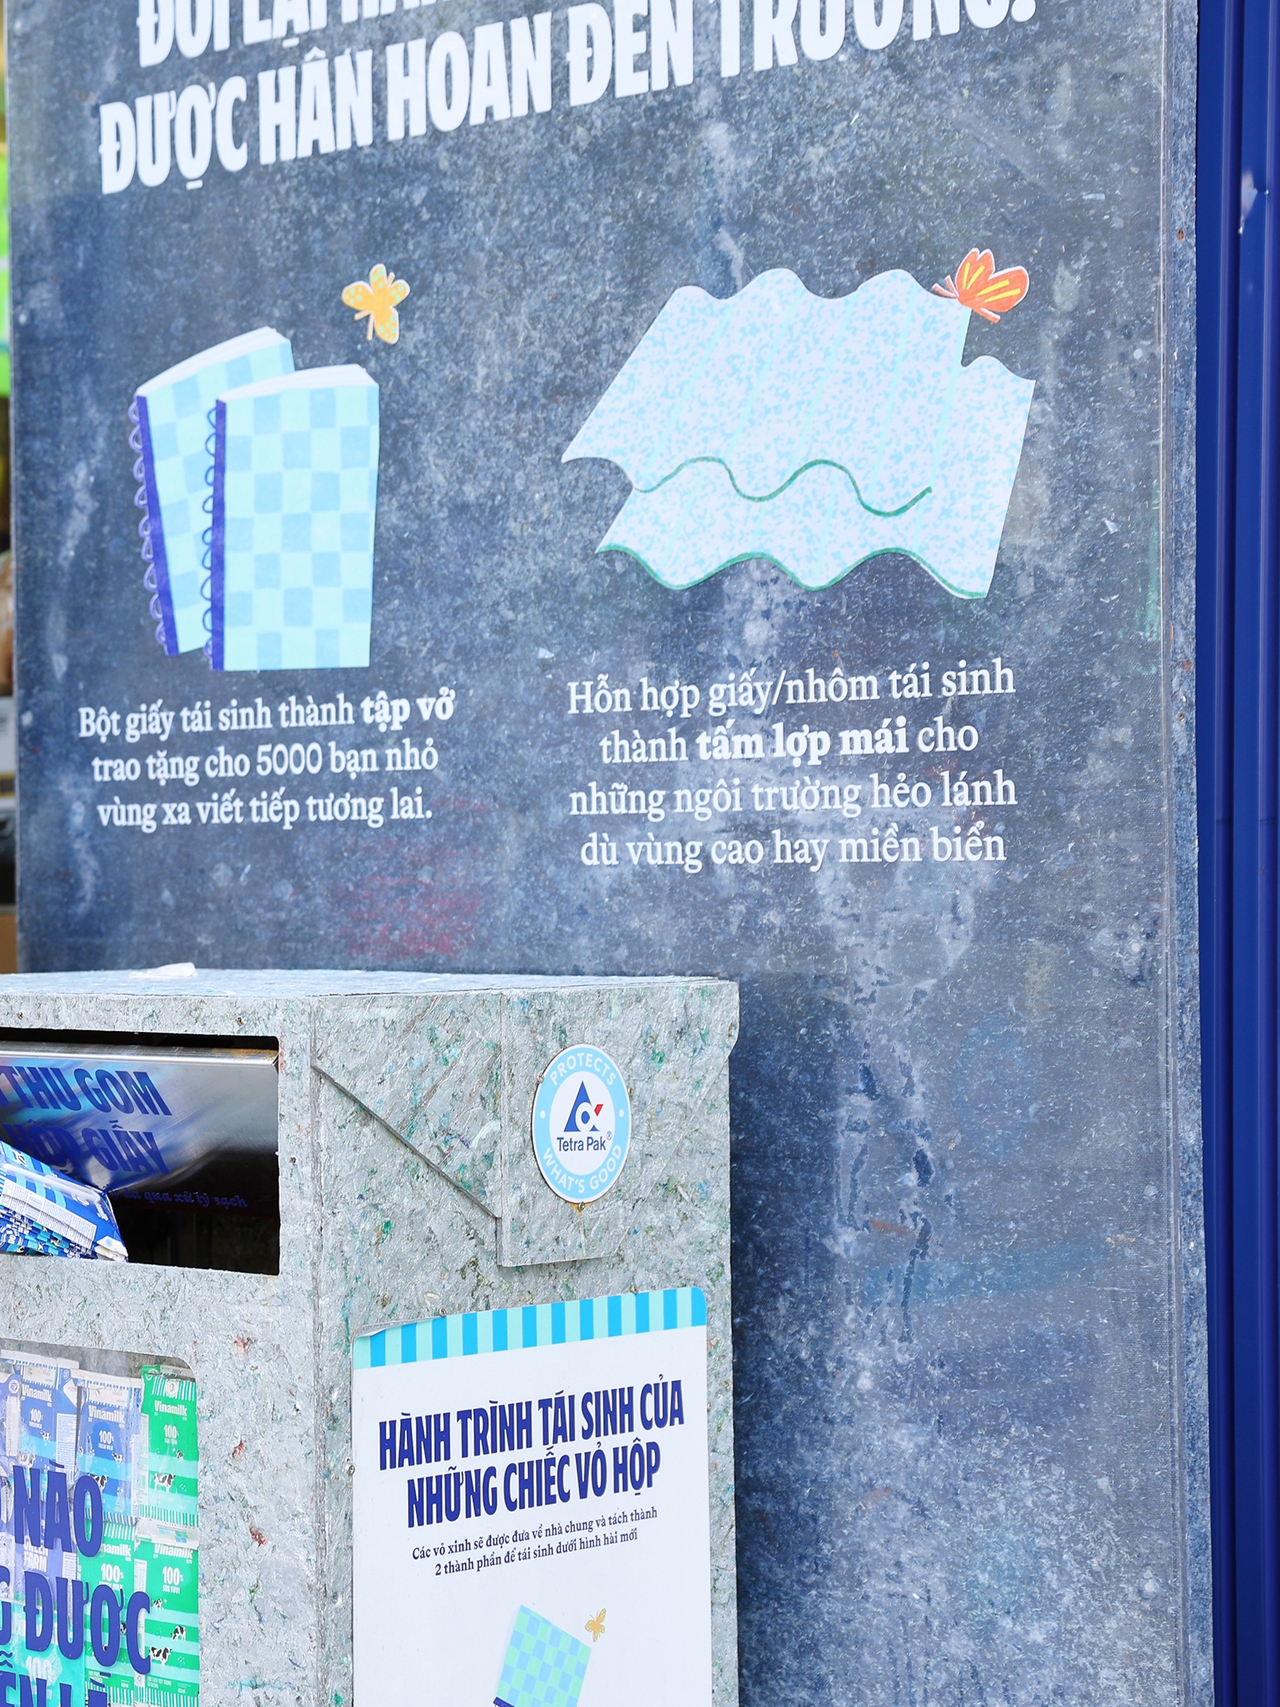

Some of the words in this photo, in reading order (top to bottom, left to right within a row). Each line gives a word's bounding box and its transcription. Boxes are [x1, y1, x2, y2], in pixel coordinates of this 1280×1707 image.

[99, 75, 248, 195] ĐƯỢC
[258, 46, 373, 165] HÂN
[385, 11, 552, 141] HOAN
[78, 706, 121, 743] Bột
[125, 699, 174, 743] giấy
[180, 700, 212, 732] tái
[218, 697, 273, 732] sinh
[278, 692, 355, 728] thành
[360, 690, 410, 732] tập
[417, 686, 456, 721] vở
[568, 674, 633, 715] Hỗn
[640, 678, 701, 722] hợp
[708, 668, 880, 717] giấy/nhôm
[888, 661, 932, 700] tái
[941, 657, 1016, 696] sinh
[92, 754, 141, 783] trao
[146, 750, 200, 787] tặng
[204, 746, 251, 779] cho
[255, 742, 323, 776] 5000
[328, 741, 379, 780] bạn
[385, 737, 439, 771] nhỏ
[599, 728, 688, 765] thành
[696, 718, 765, 761] tấm
[772, 721, 831, 767] lợp
[839, 716, 910, 756] mái
[918, 716, 979, 753] cho
[97, 797, 157, 834] vùng
[161, 802, 192, 826] xa
[196, 788, 244, 825] viết
[249, 786, 300, 831] tiếp
[305, 793, 385, 829] tương
[389, 786, 433, 820] lai.
[569, 781, 666, 822] những
[673, 777, 744, 821] ngôi
[750, 777, 862, 817] trường
[869, 772, 932, 808] hẻo
[940, 768, 1018, 807] lánh
[581, 832, 619, 866] dù
[625, 832, 703, 874] vùng
[711, 840, 764, 865] cao
[772, 828, 830, 872] hay
[838, 824, 923, 864] miền
[929, 821, 1007, 862] biển
[73, 1067, 172, 1116] GOM
[549, 1052, 617, 1086] PROTECTS
[81, 1119, 170, 1175] GIẤY
[542, 1147, 586, 1194] WHAT'S
[589, 1144, 622, 1190] GOOD
[557, 1136, 584, 1152] Tetra
[586, 1136, 606, 1151] Pak
[22, 1384, 52, 1402] Vinamilk
[88, 1405, 125, 1423] Vinamilk
[154, 1400, 188, 1417] Vinamilk
[379, 1412, 451, 1471] HÀNH
[456, 1399, 533, 1458] TRÌNH
[538, 1390, 575, 1446] TÁI
[581, 1385, 634, 1440] SINH
[640, 1374, 685, 1430] CỦA
[407, 1465, 497, 1528] NHỮNG
[503, 1445, 571, 1511] CHIẾC
[575, 1442, 608, 1500] VỎ
[613, 1437, 661, 1495] HỘP
[13, 1459, 103, 1558] NÀO
[412, 1546, 431, 1560] Các
[433, 1542, 446, 1556] vỏ
[447, 1539, 472, 1554] xinh
[473, 1536, 484, 1550] sẽ
[486, 1531, 510, 1549] được
[512, 1529, 531, 1544] đưa
[532, 1523, 543, 1540] về
[545, 1522, 563, 1537] nhà
[564, 1518, 594, 1535] chung
[595, 1514, 607, 1528] và
[608, 1511, 629, 1526] tách
[630, 1506, 658, 1522] thành
[100, 1544, 131, 1557] namilk
[154, 1543, 193, 1559] Vinamilk
[435, 1563, 442, 1576] 2
[443, 1557, 475, 1575] thành
[476, 1550, 502, 1572] phần
[503, 1546, 516, 1564] để
[518, 1547, 532, 1561] tái
[533, 1542, 554, 1559] sinh
[578, 1535, 602, 1550] hình
[603, 1532, 619, 1546] hài
[619, 1527, 638, 1543] mới
[23, 1570, 151, 1678] ĐƯỢC
